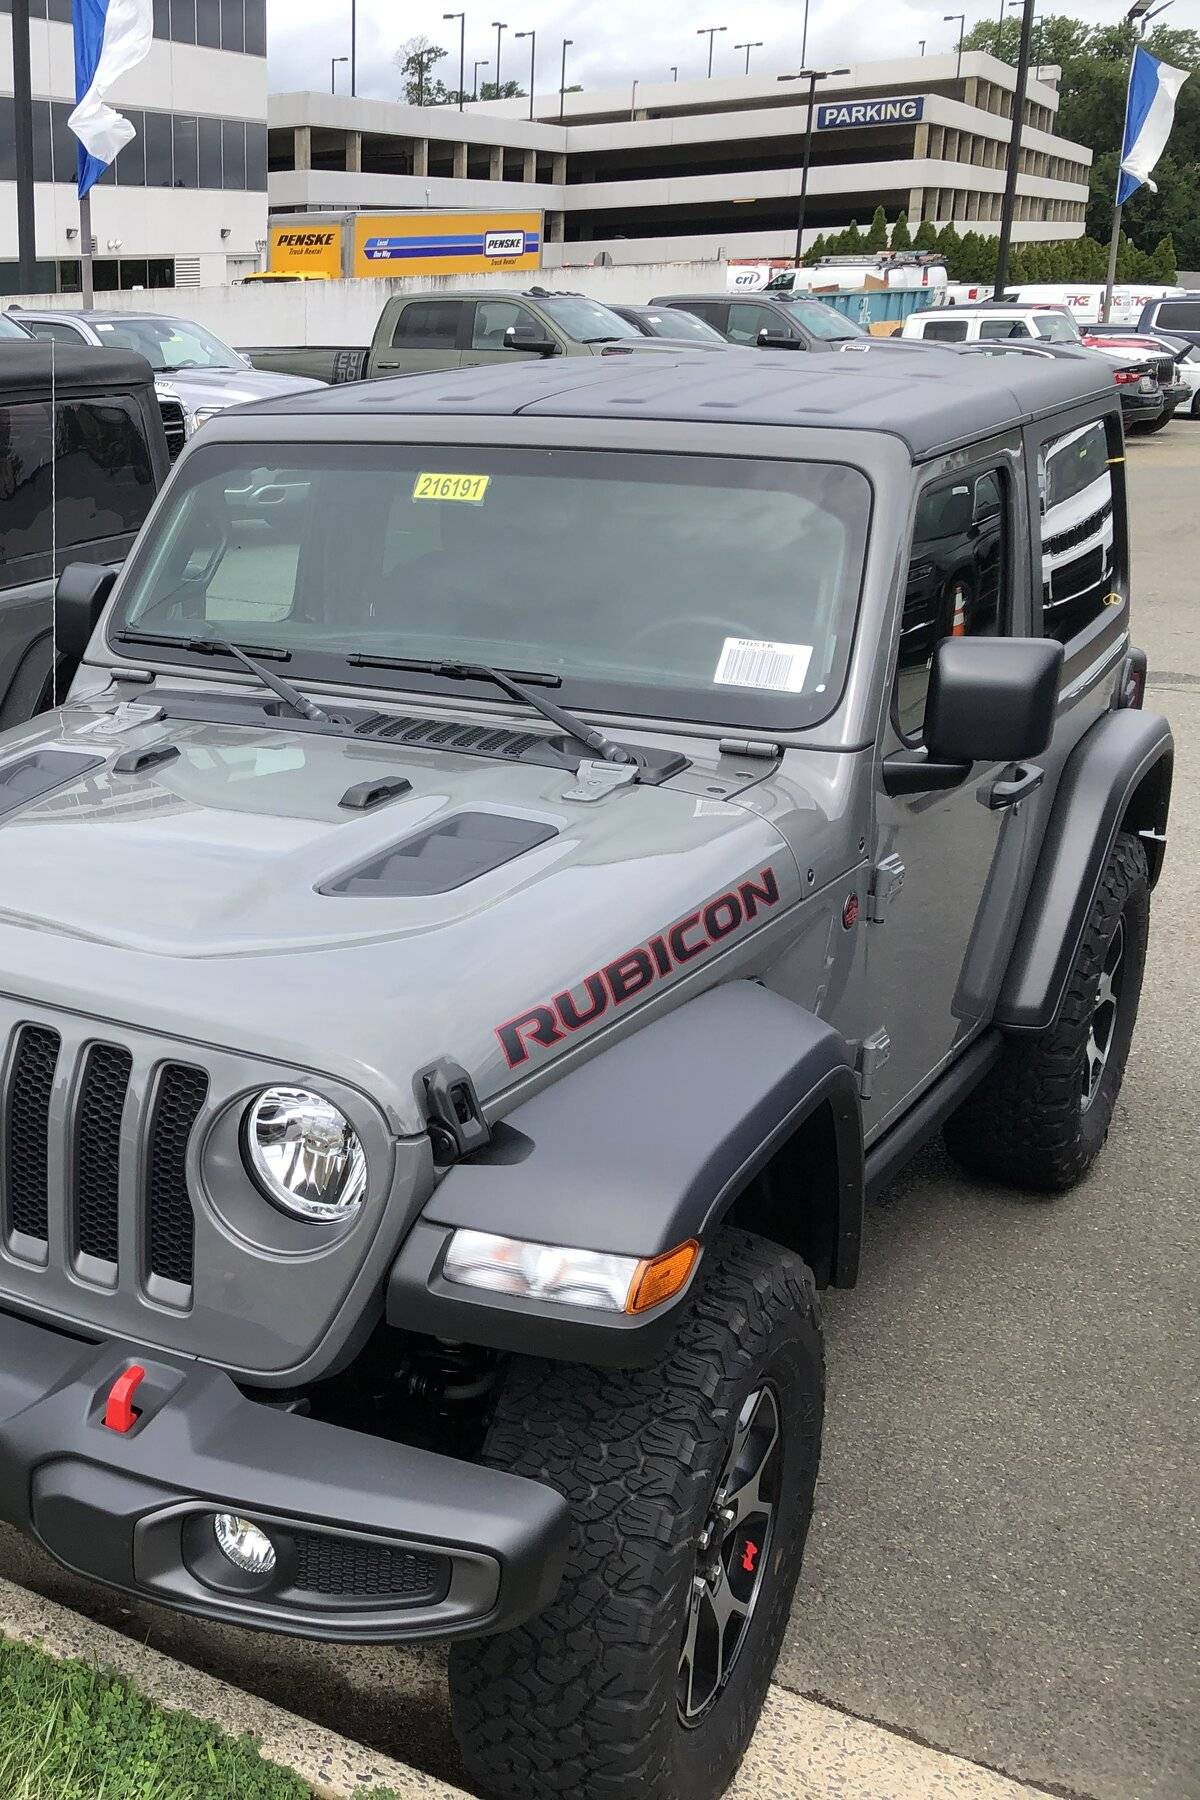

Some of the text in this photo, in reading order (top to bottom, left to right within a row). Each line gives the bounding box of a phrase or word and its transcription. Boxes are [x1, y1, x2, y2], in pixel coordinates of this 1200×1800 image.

[824, 100, 918, 126] PARKING
[277, 233, 336, 247] PENSKE
[487, 238, 522, 249] PENSKE
[288, 247, 323, 256] Truck Rental
[490, 258, 517, 266] Truck Rental
[735, 273, 755, 285] cri
[1066, 295, 1091, 306] TKE
[418, 477, 483, 497] 216191
[494, 866, 782, 1070] RUBICON
